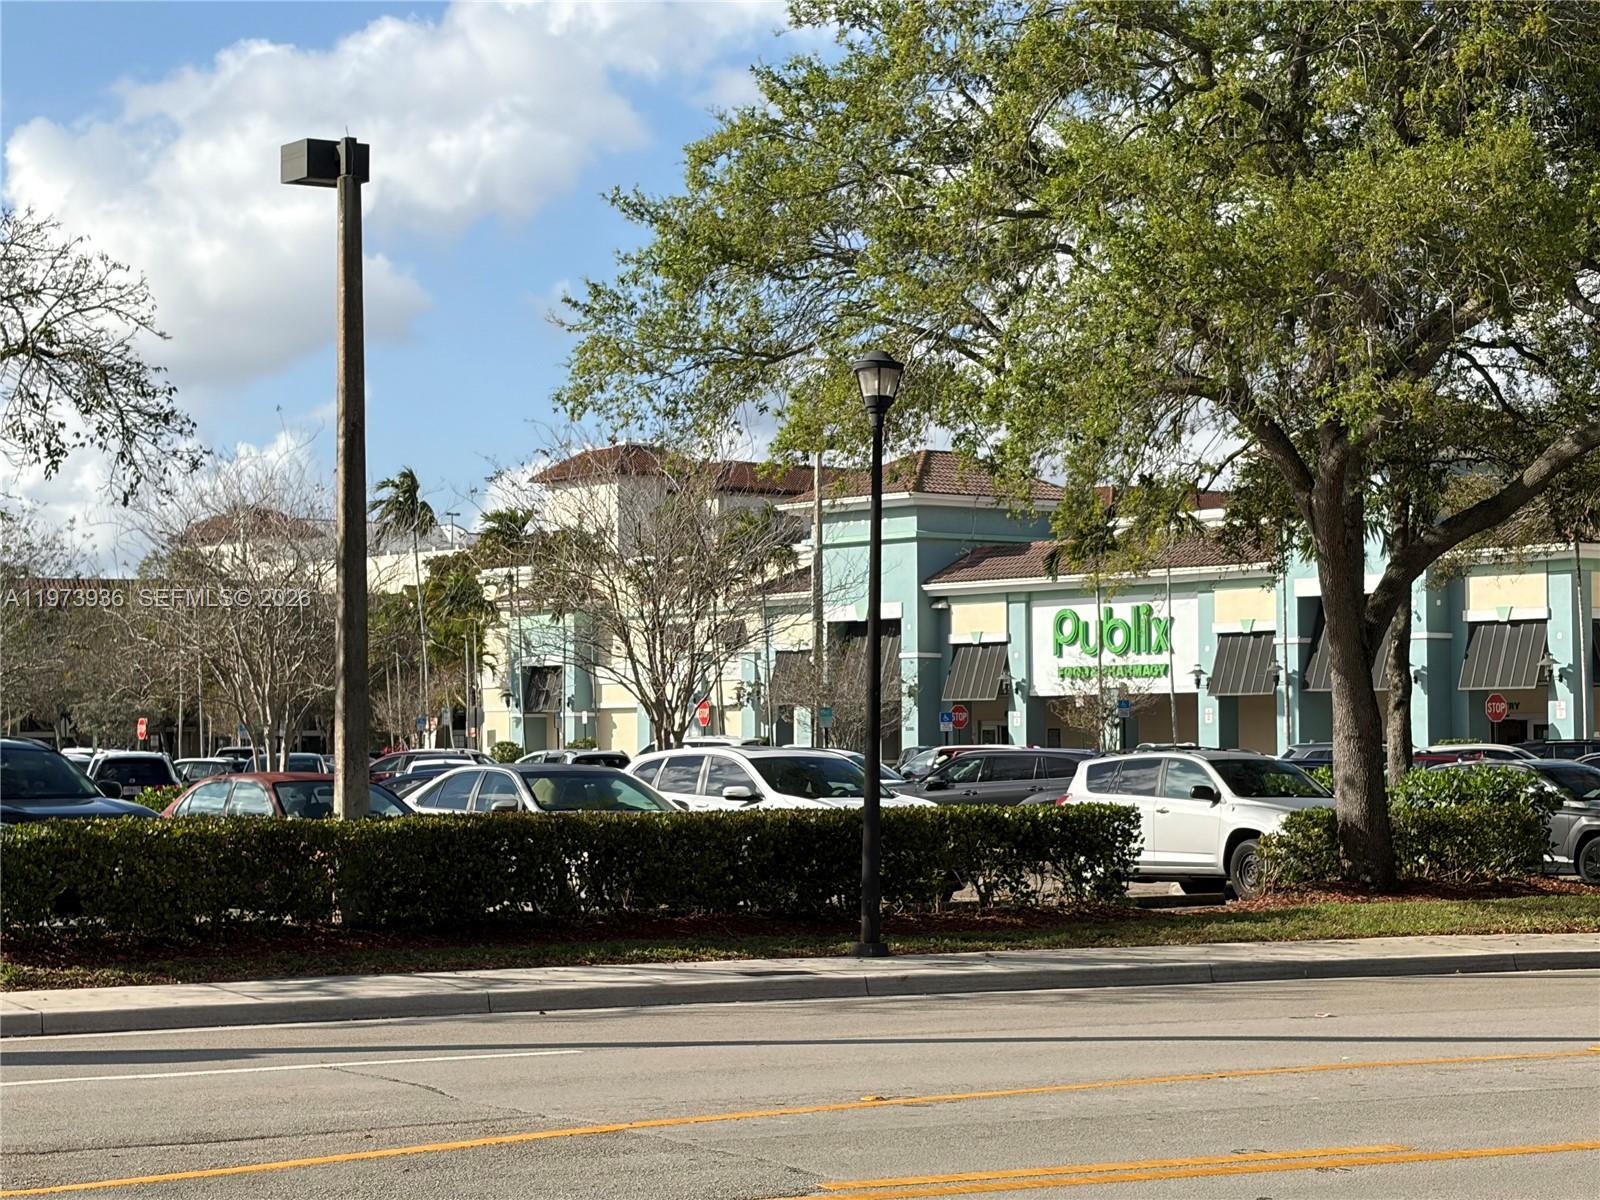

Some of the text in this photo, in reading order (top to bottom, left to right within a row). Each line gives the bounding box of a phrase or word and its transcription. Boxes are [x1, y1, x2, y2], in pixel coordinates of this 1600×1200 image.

[1053, 603, 1174, 658] Publix
[1487, 702, 1506, 713] STOP
[951, 712, 967, 721] STOP
